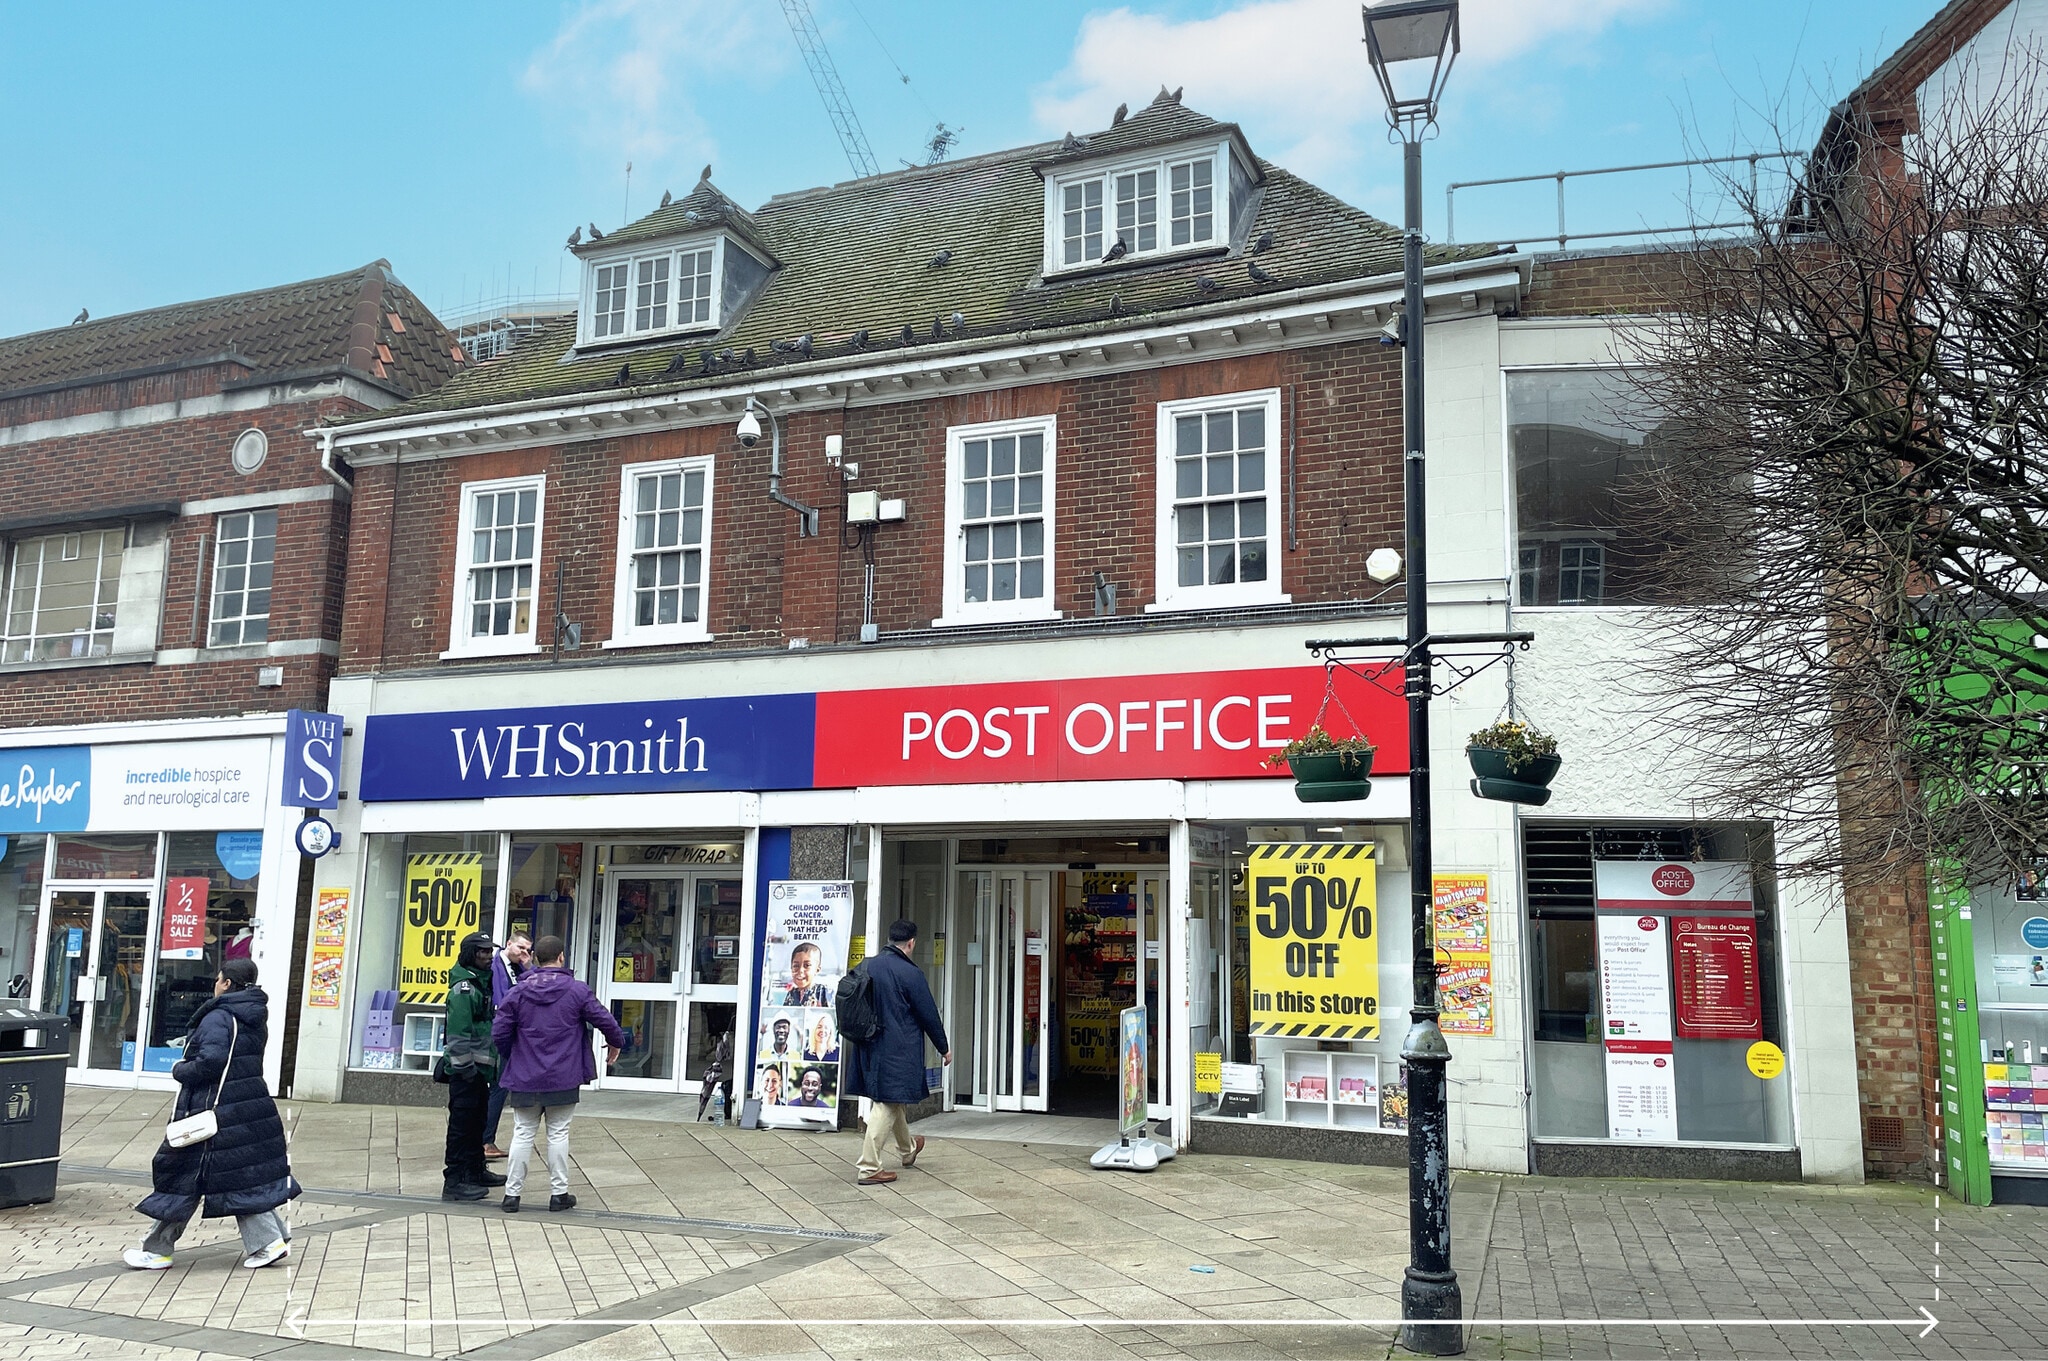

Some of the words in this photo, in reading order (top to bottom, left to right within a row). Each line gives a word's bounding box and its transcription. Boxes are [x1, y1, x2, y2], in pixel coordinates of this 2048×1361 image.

[303, 718, 337, 739] WH
[902, 705, 1050, 760] POST
[1065, 694, 1293, 755] OFFICE
[450, 716, 709, 781] WHSmith
[126, 768, 192, 784] incredible
[193, 766, 241, 786] hospice
[298, 738, 334, 802] S
[15, 764, 82, 824] Ryder
[123, 790, 146, 806] and
[148, 788, 222, 809] neurological
[223, 790, 250, 803] care
[644, 846, 682, 861] GIFT
[683, 848, 727, 864] WRAP
[434, 868, 444, 877] UP
[444, 867, 452, 877] TO
[1295, 862, 1310, 874] UP
[1311, 862, 1326, 874] TO
[1661, 871, 1686, 880] POST
[1464, 888, 1485, 896] COURT
[1656, 879, 1690, 888] OFFICE
[408, 877, 477, 928] 50%
[1255, 875, 1372, 940] 50%
[171, 914, 198, 926] PRICE
[1728, 924, 1750, 932] Change
[170, 926, 194, 938] SALE
[423, 929, 456, 958] OFF
[634, 955, 648, 970] alf
[1286, 942, 1340, 978] OFF
[402, 966, 413, 984] in
[416, 966, 437, 985] this
[1467, 968, 1489, 978] COURT
[1253, 990, 1272, 1012] in
[1276, 990, 1315, 1014] this
[1320, 993, 1376, 1016] store
[1070, 1026, 1104, 1047] 50%
[1080, 1047, 1096, 1058] OFF
